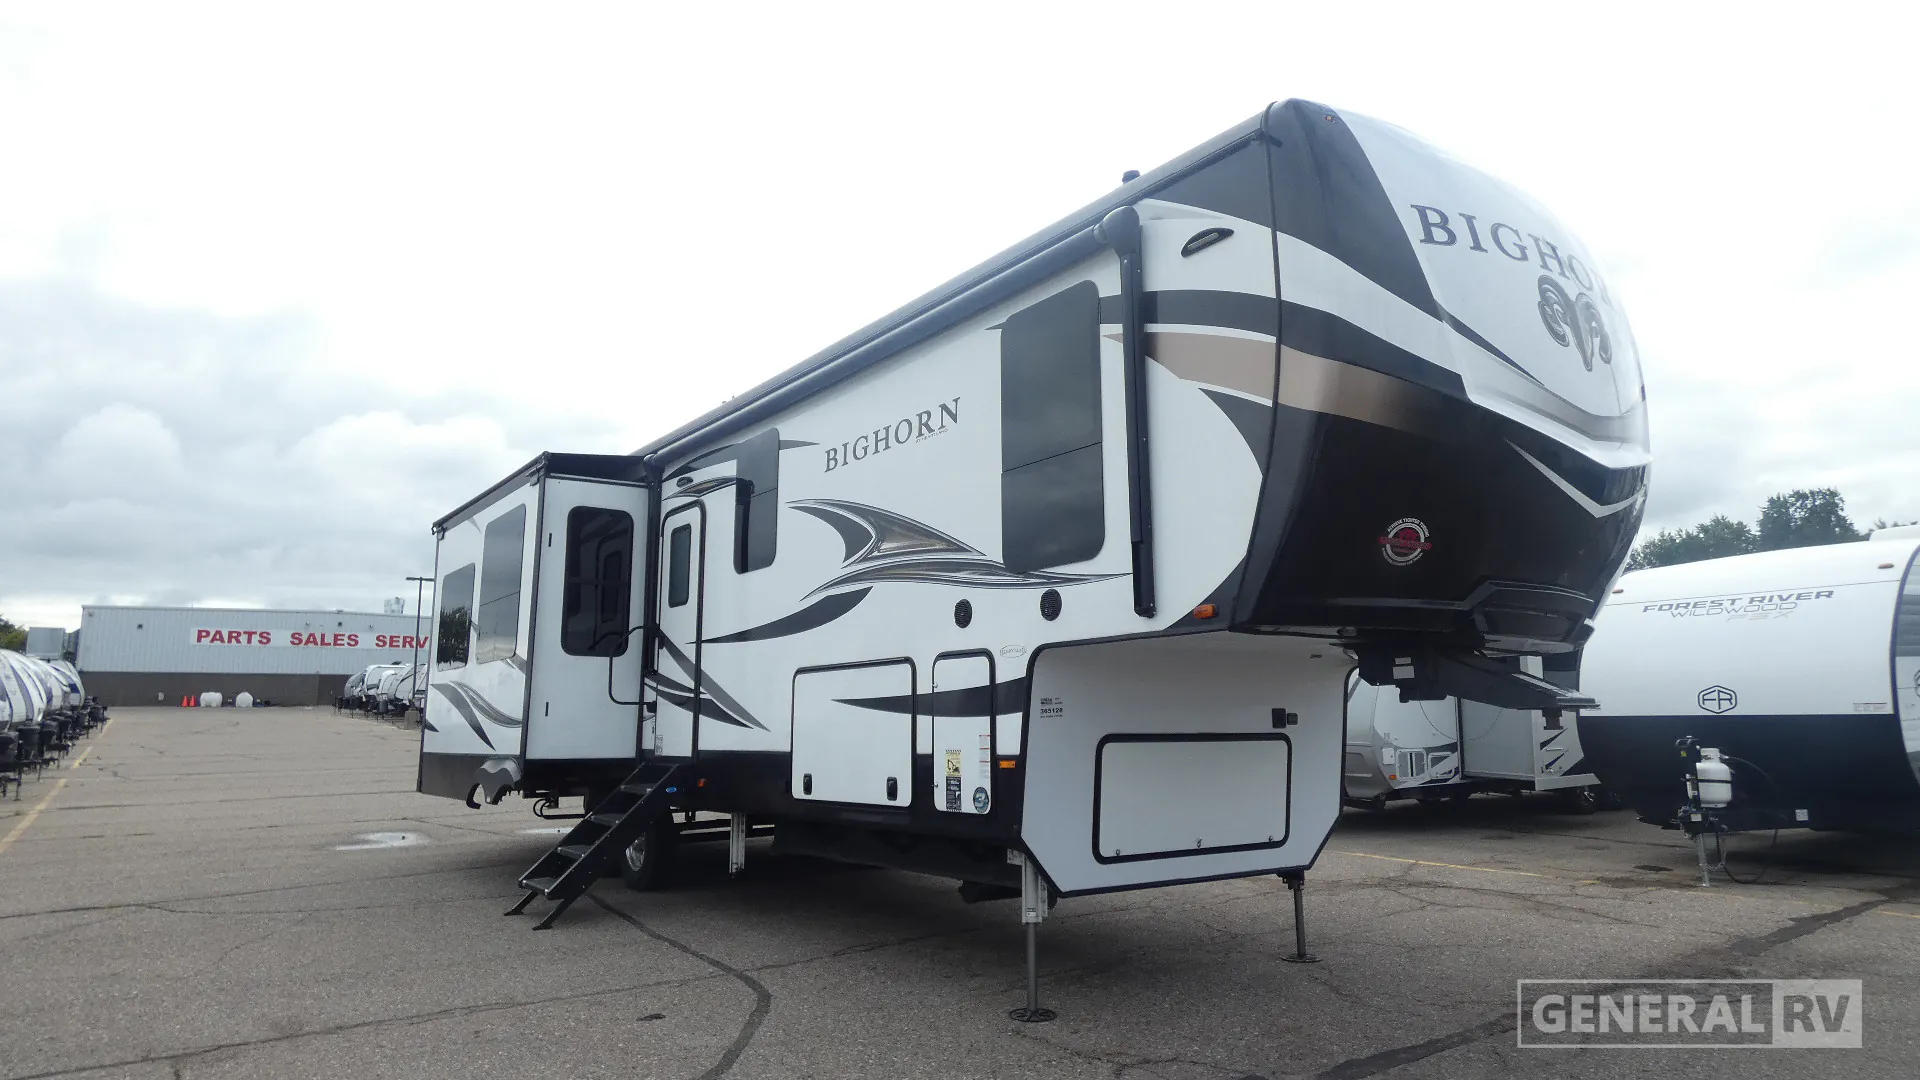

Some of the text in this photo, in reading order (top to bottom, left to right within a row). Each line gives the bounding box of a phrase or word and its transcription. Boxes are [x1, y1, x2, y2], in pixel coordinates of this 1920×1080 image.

[824, 397, 960, 473] BIGHORN
[1642, 590, 1834, 613] FOREST RIVER
[1670, 601, 1798, 618] WILDWOOD
[196, 629, 272, 645] PARTS
[289, 632, 360, 647] SALES
